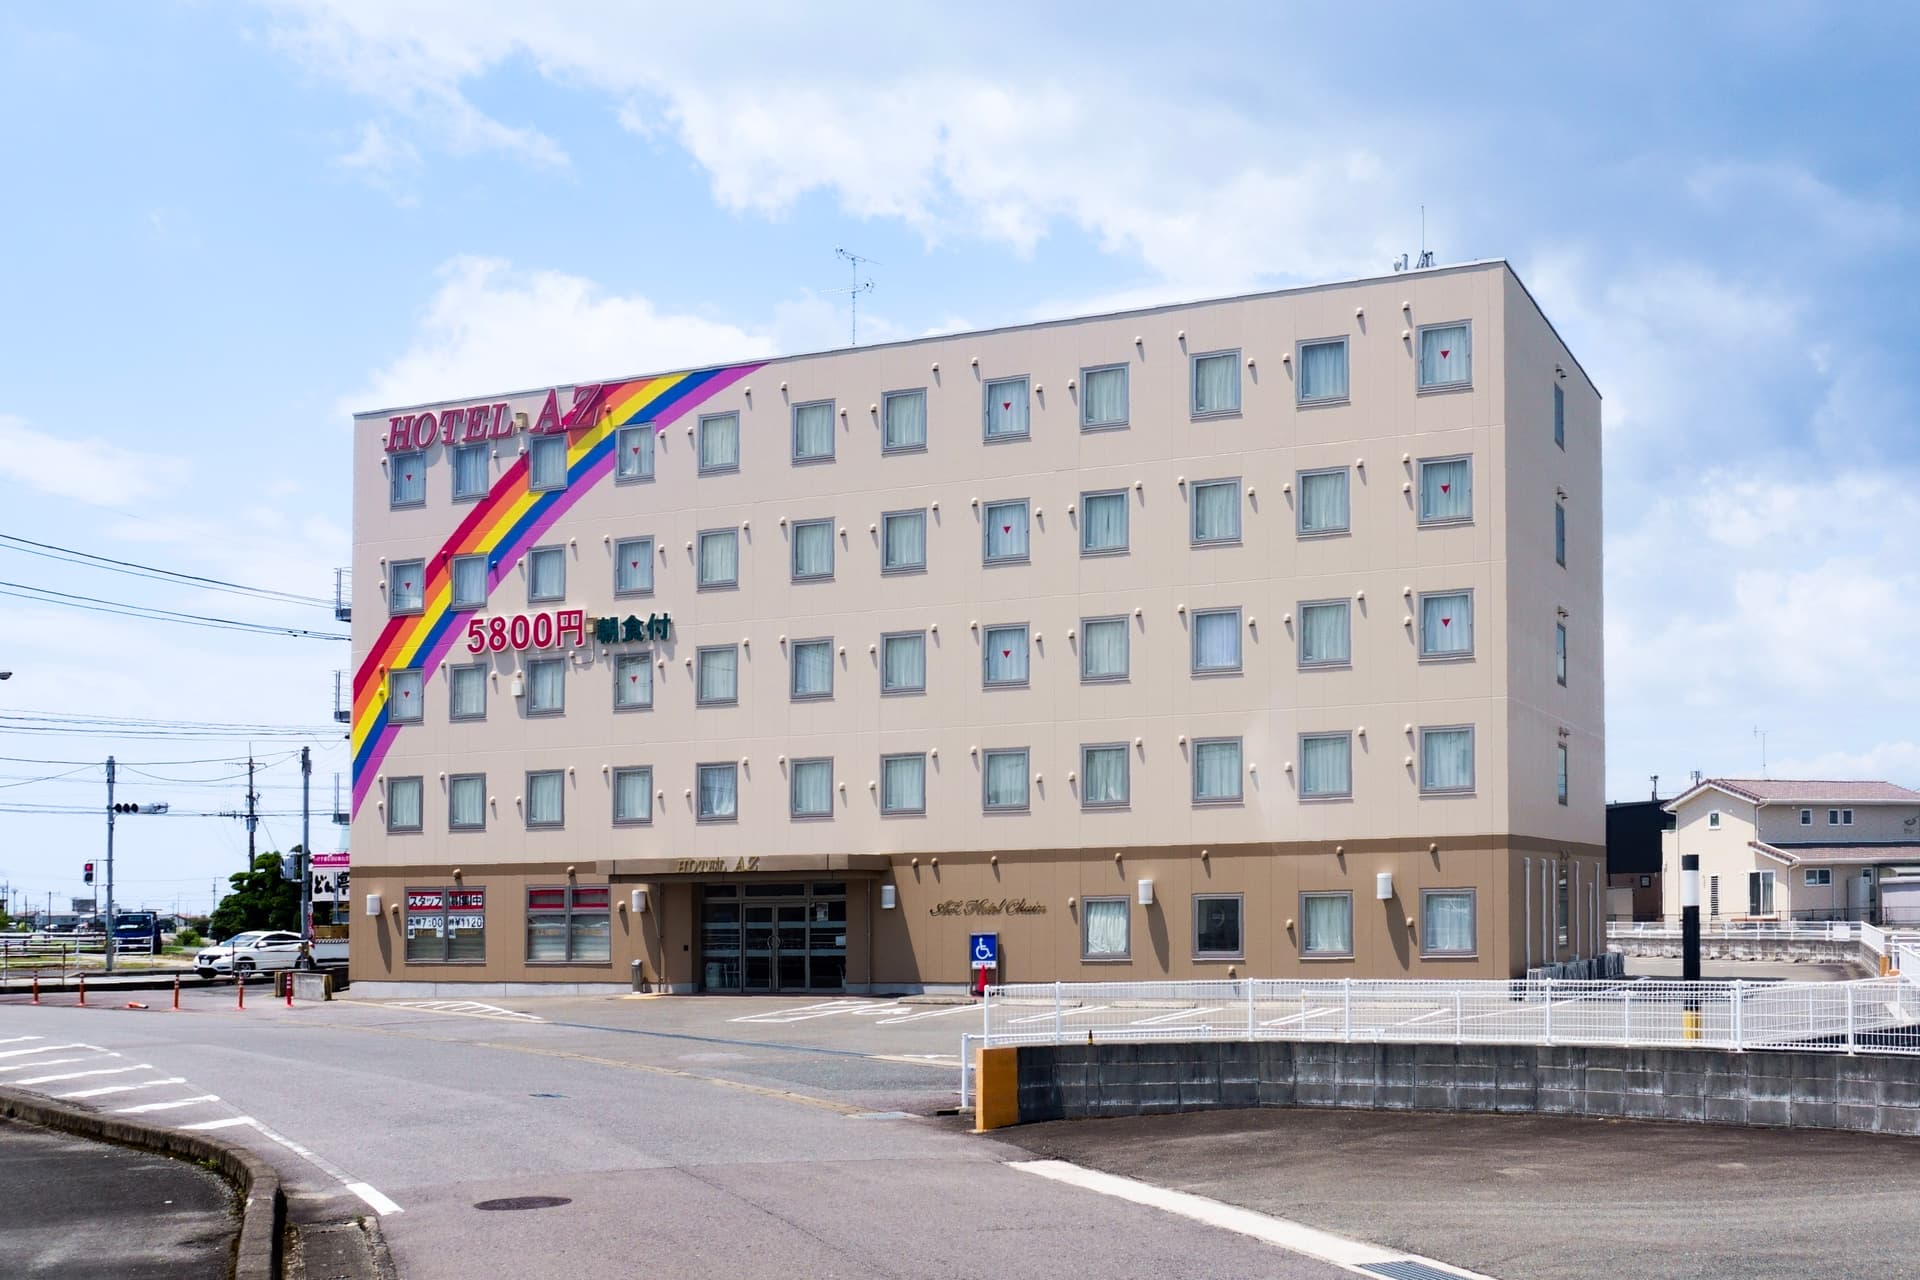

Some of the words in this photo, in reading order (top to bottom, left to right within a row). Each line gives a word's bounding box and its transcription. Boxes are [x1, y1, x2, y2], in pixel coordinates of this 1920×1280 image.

[385, 403, 515, 452] HOTEL
[529, 384, 602, 434] AZ
[467, 609, 585, 654] 5800円
[596, 612, 672, 645] 朝食付
[734, 856, 761, 872] AZ
